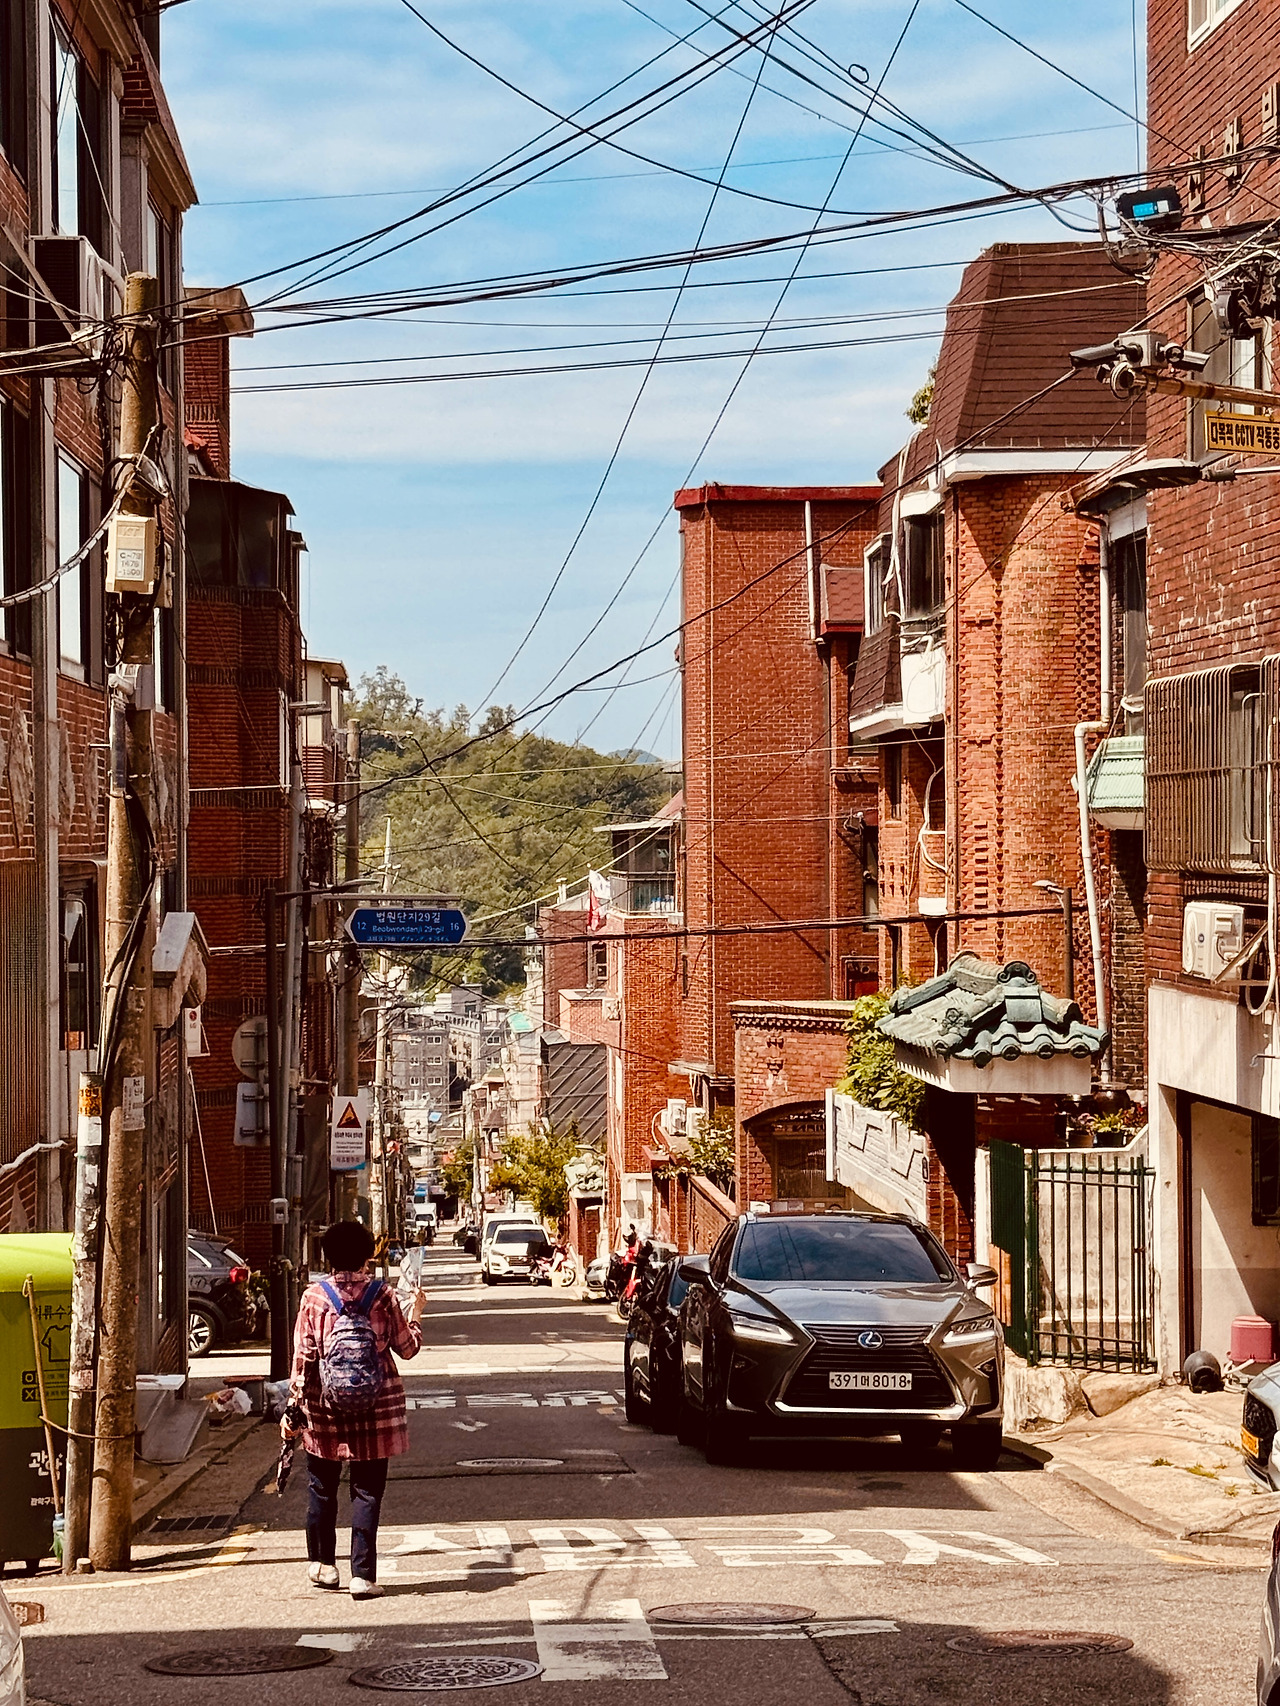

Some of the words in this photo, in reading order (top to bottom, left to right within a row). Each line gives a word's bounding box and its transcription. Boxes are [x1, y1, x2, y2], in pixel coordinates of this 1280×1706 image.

[1210, 421, 1234, 446] 다목적
[1235, 423, 1255, 447] CCTV
[1256, 425, 1280, 450] 작동중
[376, 911, 441, 924] 법원단지29길
[357, 921, 367, 930] 12
[450, 922, 460, 931] 16
[376, 1526, 1060, 1578] 진입금지
